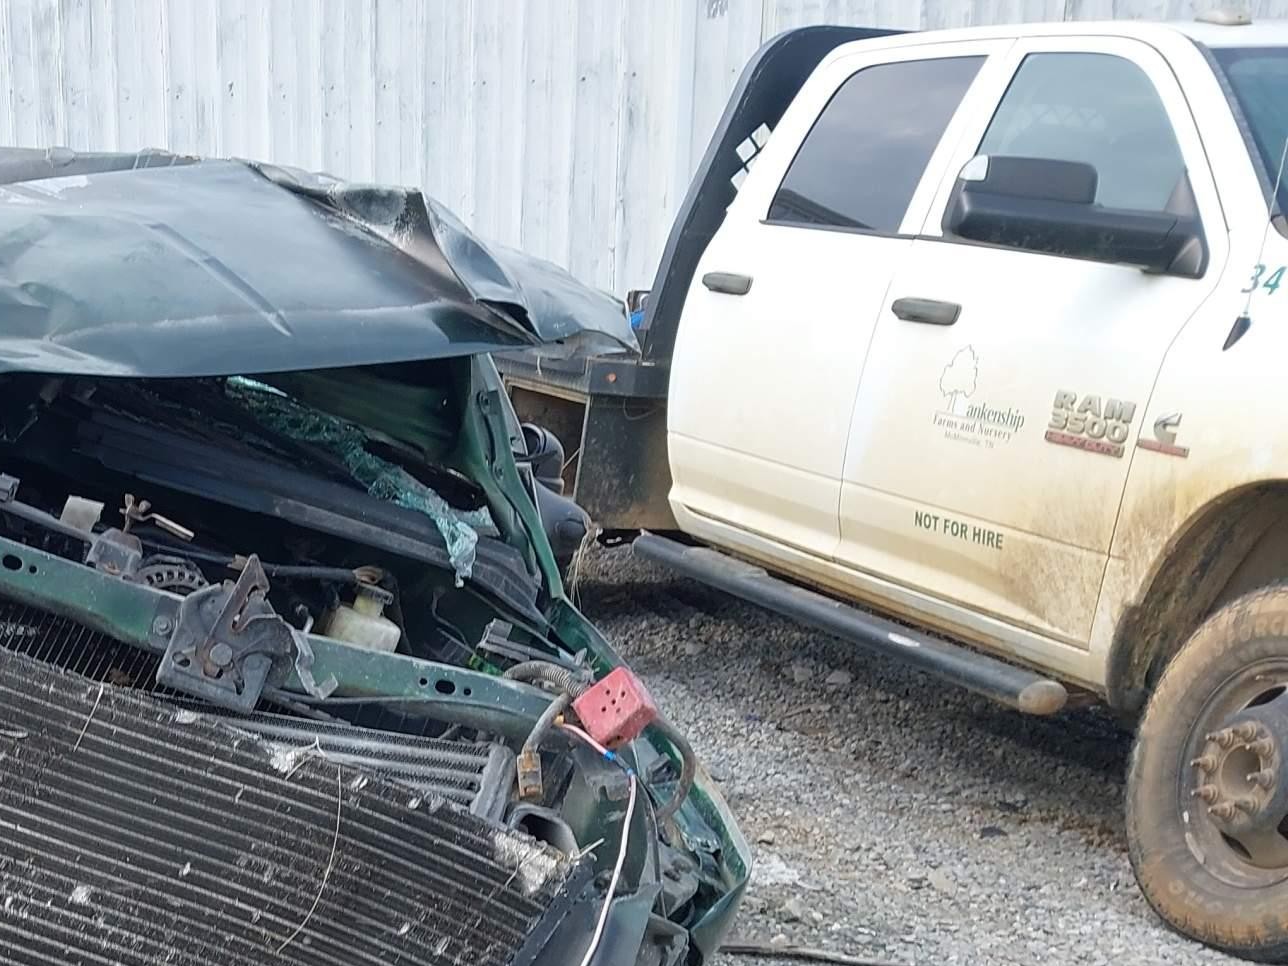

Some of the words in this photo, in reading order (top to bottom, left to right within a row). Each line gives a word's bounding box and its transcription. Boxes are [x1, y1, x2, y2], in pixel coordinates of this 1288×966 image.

[1241, 264, 1287, 295] 34
[1053, 389, 1136, 424] RAM
[933, 414, 958, 430] Farms
[960, 422, 977, 433] and
[978, 424, 1012, 444] Nursery
[1048, 409, 1129, 444] 3500
[915, 511, 940, 531] NOT
[943, 518, 968, 541] FOR
[972, 526, 1004, 550] HIRE
